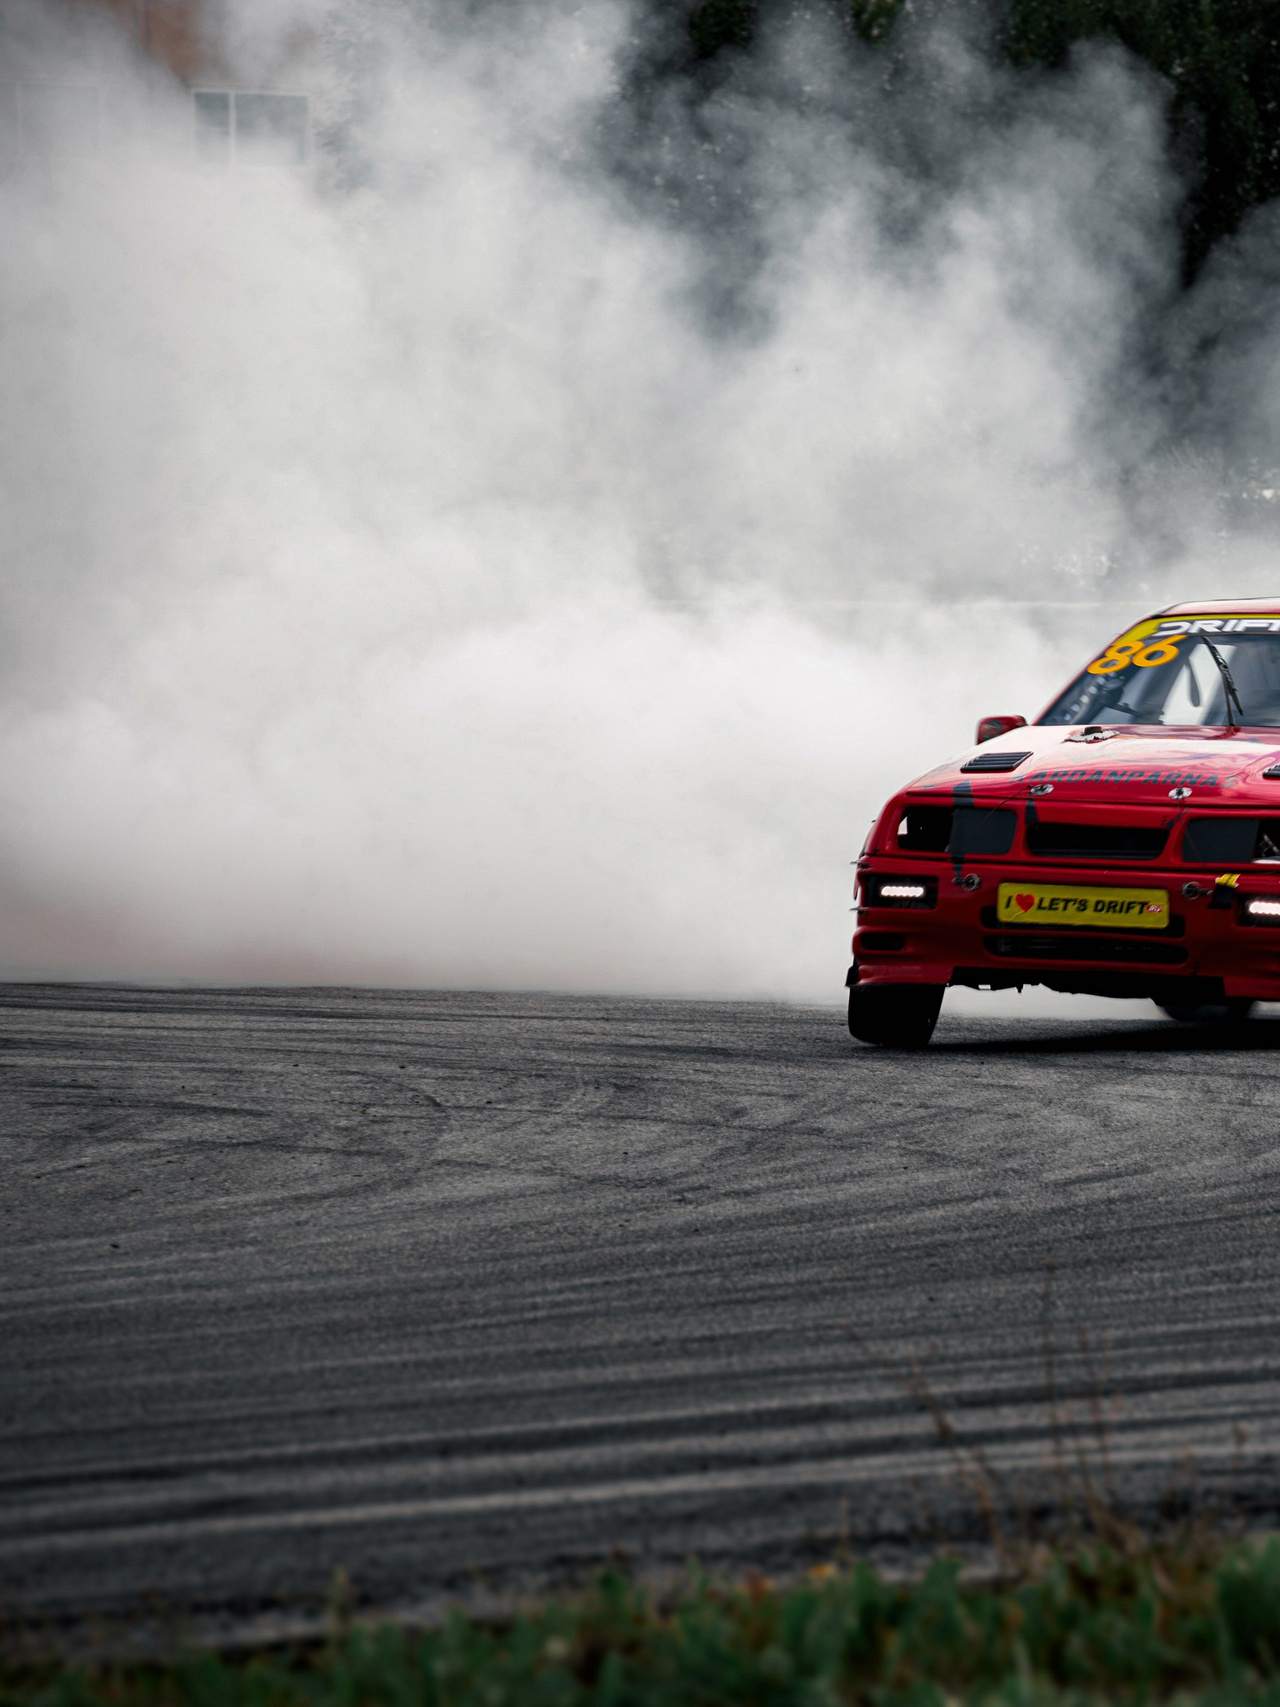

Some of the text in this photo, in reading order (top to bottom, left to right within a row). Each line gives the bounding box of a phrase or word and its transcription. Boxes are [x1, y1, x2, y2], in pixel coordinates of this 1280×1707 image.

[1086, 635, 1188, 675] 86
[1004, 895, 1014, 910] I
[1036, 896, 1089, 913] LET'S
